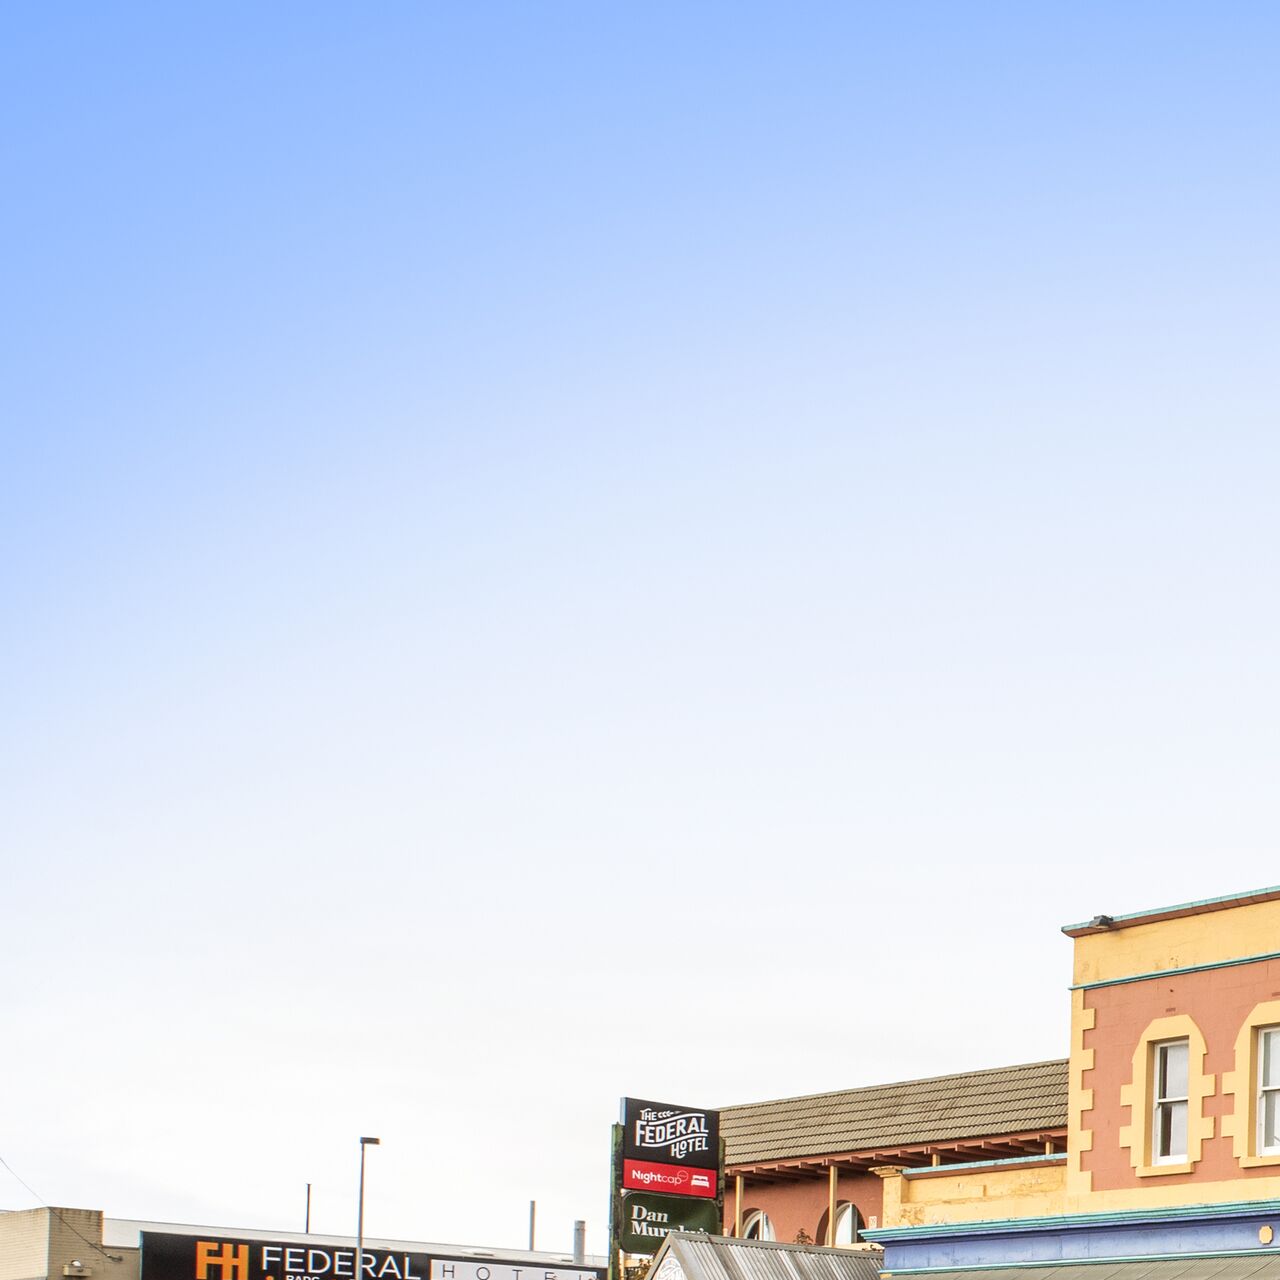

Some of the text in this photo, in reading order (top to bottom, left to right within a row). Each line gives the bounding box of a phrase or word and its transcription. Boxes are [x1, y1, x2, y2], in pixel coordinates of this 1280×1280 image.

[640, 1108, 657, 1120] THE
[635, 1117, 709, 1146] FEDERAL
[671, 1138, 709, 1159] HOTEL
[631, 1169, 682, 1186] Nightcap
[631, 1204, 669, 1223] Dan
[261, 1246, 421, 1280] FEDERAL
